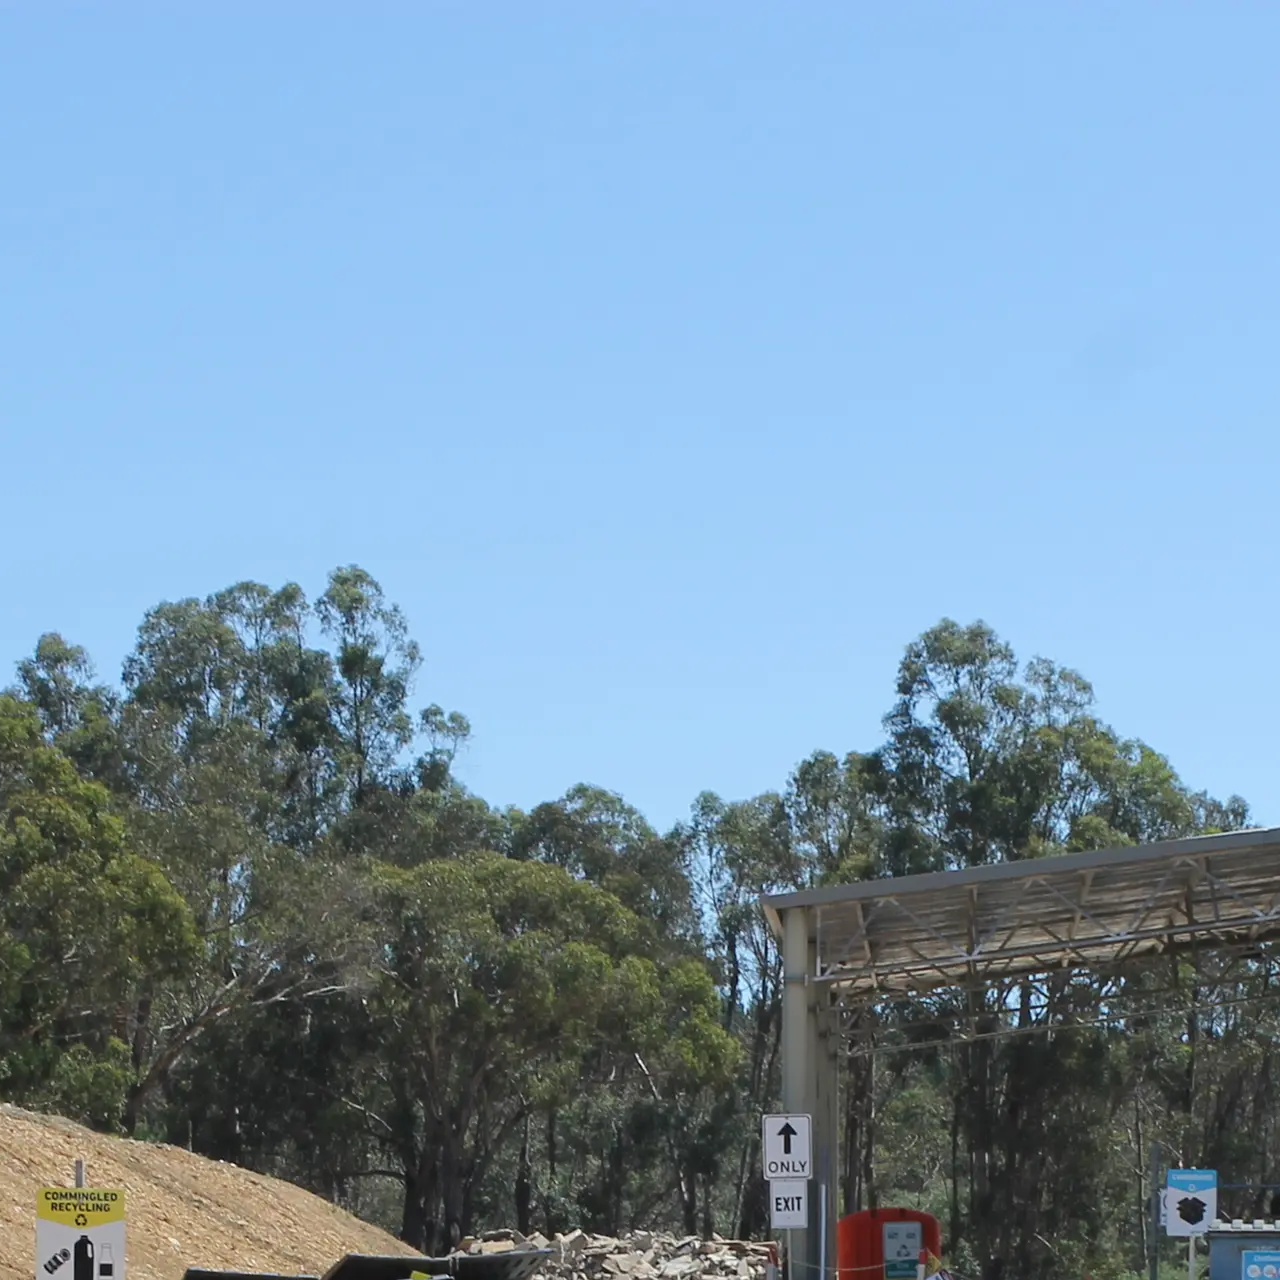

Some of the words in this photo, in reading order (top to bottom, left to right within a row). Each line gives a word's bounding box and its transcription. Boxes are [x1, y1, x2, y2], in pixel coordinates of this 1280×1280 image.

[768, 1161, 807, 1173] ONLY
[44, 1191, 118, 1201] COMMINGLED
[51, 1202, 110, 1212] RECYCLING
[775, 1197, 802, 1212] EXIT
